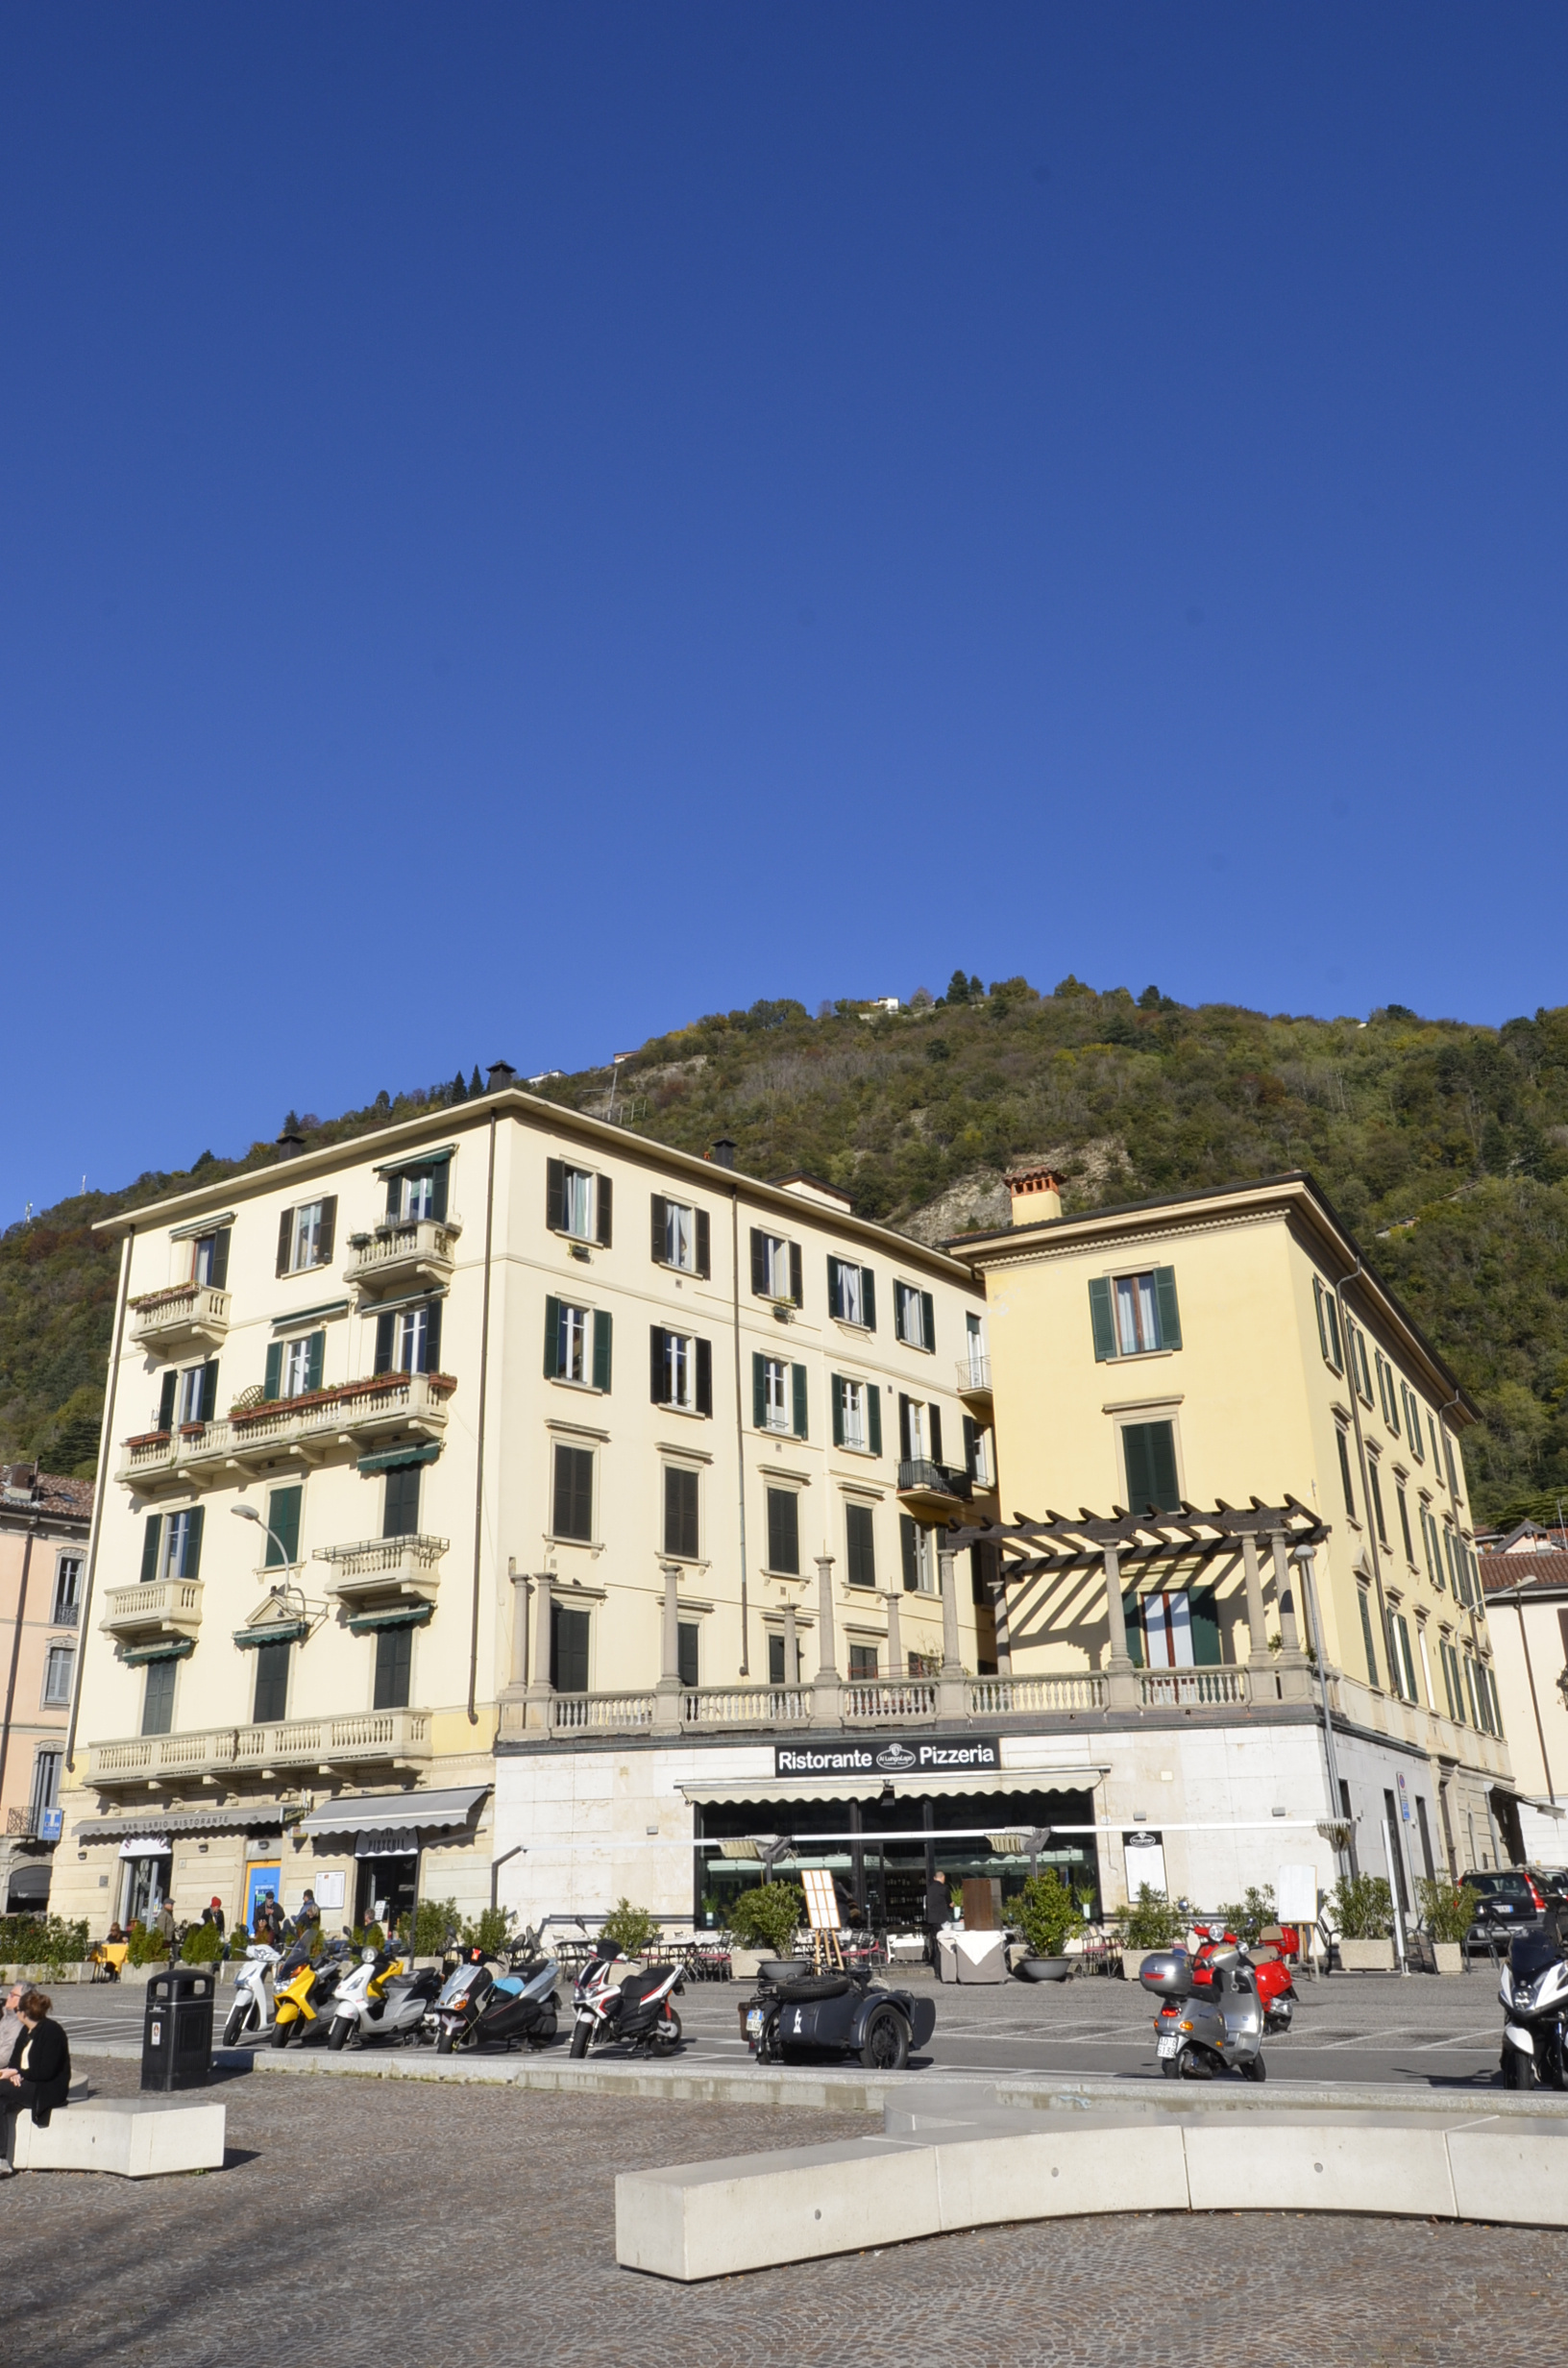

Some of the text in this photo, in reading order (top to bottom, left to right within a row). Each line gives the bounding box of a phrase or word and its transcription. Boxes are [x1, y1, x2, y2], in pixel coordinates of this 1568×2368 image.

[778, 1743, 994, 1770] Ristorante Pizzeria
[46, 1809, 60, 1827] T
[143, 1820, 169, 1829] LARIO
[173, 1815, 230, 1827] RISTORANTE
[368, 1838, 404, 1851] PIZZERIA
